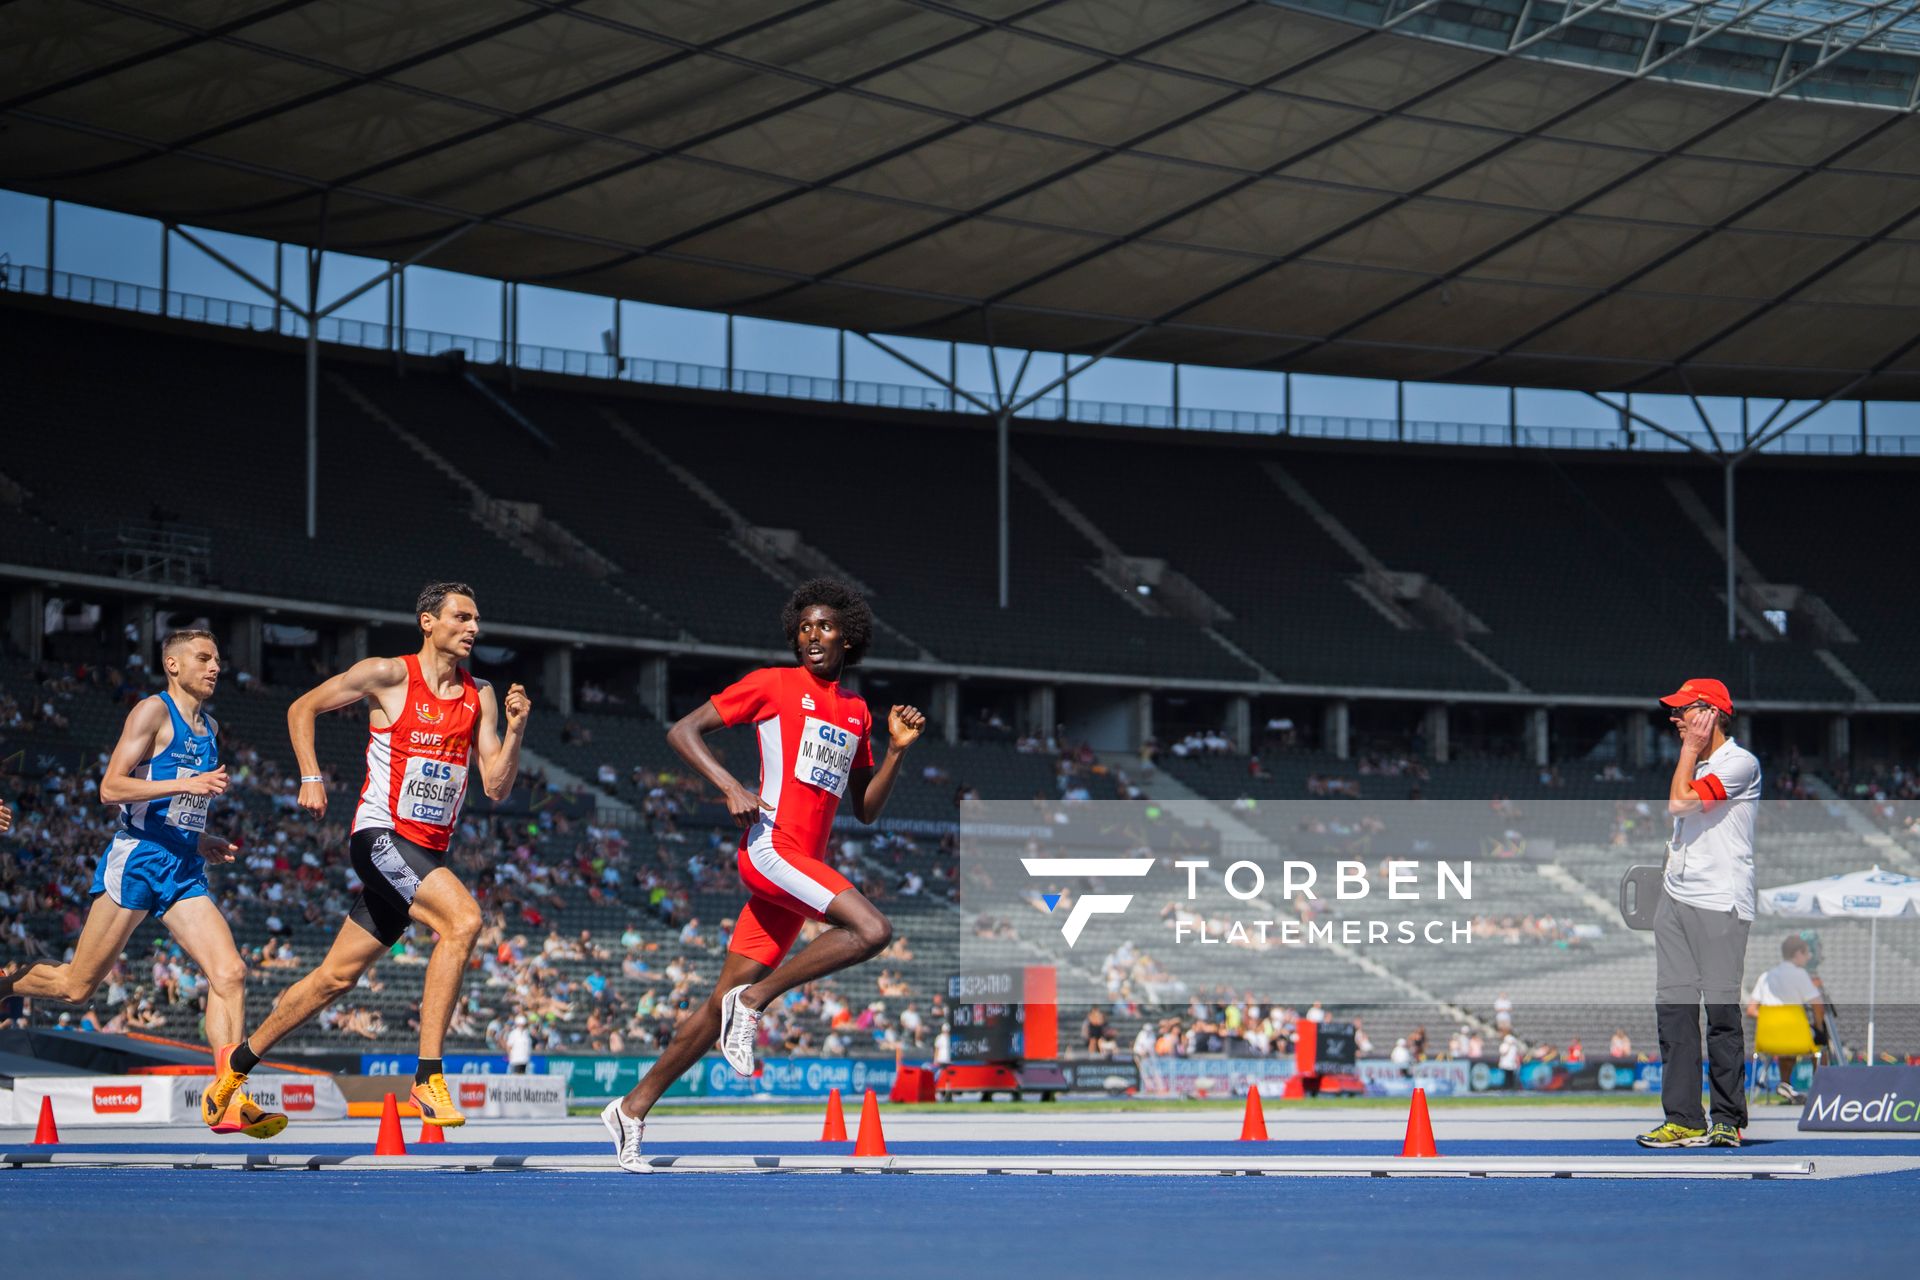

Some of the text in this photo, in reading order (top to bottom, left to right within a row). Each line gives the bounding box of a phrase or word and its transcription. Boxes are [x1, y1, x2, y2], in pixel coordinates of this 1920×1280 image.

[410, 730, 443, 747] SWE
[819, 725, 847, 747] GLS
[421, 762, 451, 781] GLS
[406, 780, 457, 804] KESSLER
[95, 1094, 138, 1106] bett1.de
[504, 1087, 522, 1102] sind
